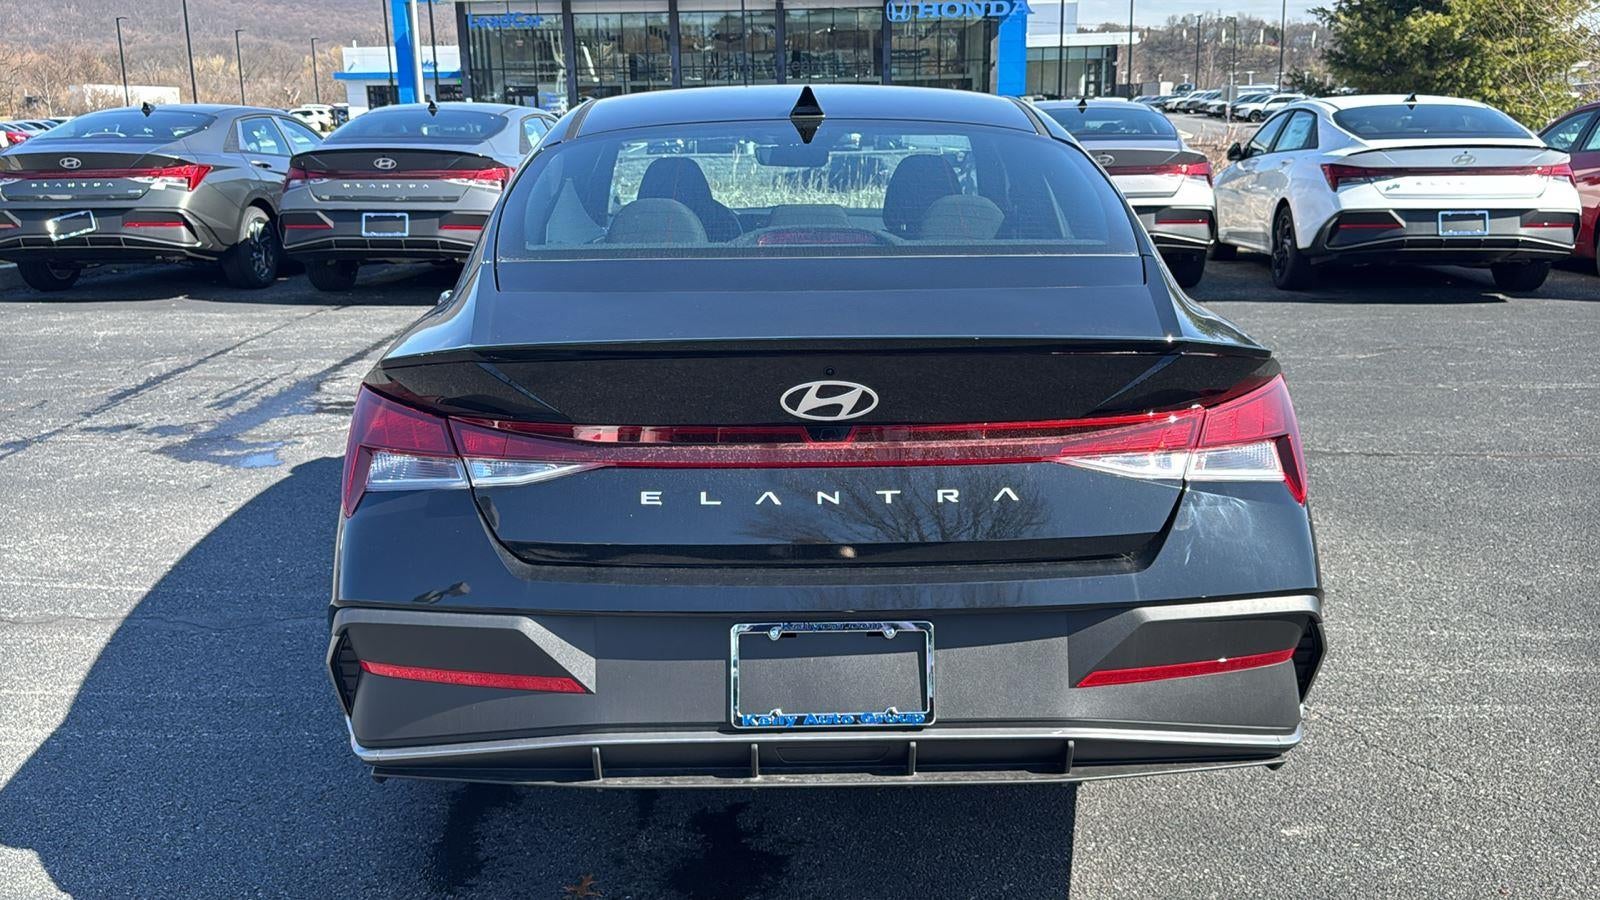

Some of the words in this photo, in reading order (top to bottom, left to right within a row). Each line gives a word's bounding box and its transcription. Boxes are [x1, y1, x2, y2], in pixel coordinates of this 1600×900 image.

[917, 0, 1034, 19] HONDA
[467, 12, 544, 29] LeadCar
[640, 487, 1020, 506] ELANTRA
[742, 713, 797, 728] Kelly
[803, 713, 855, 725] Auto
[860, 712, 926, 726] Group
